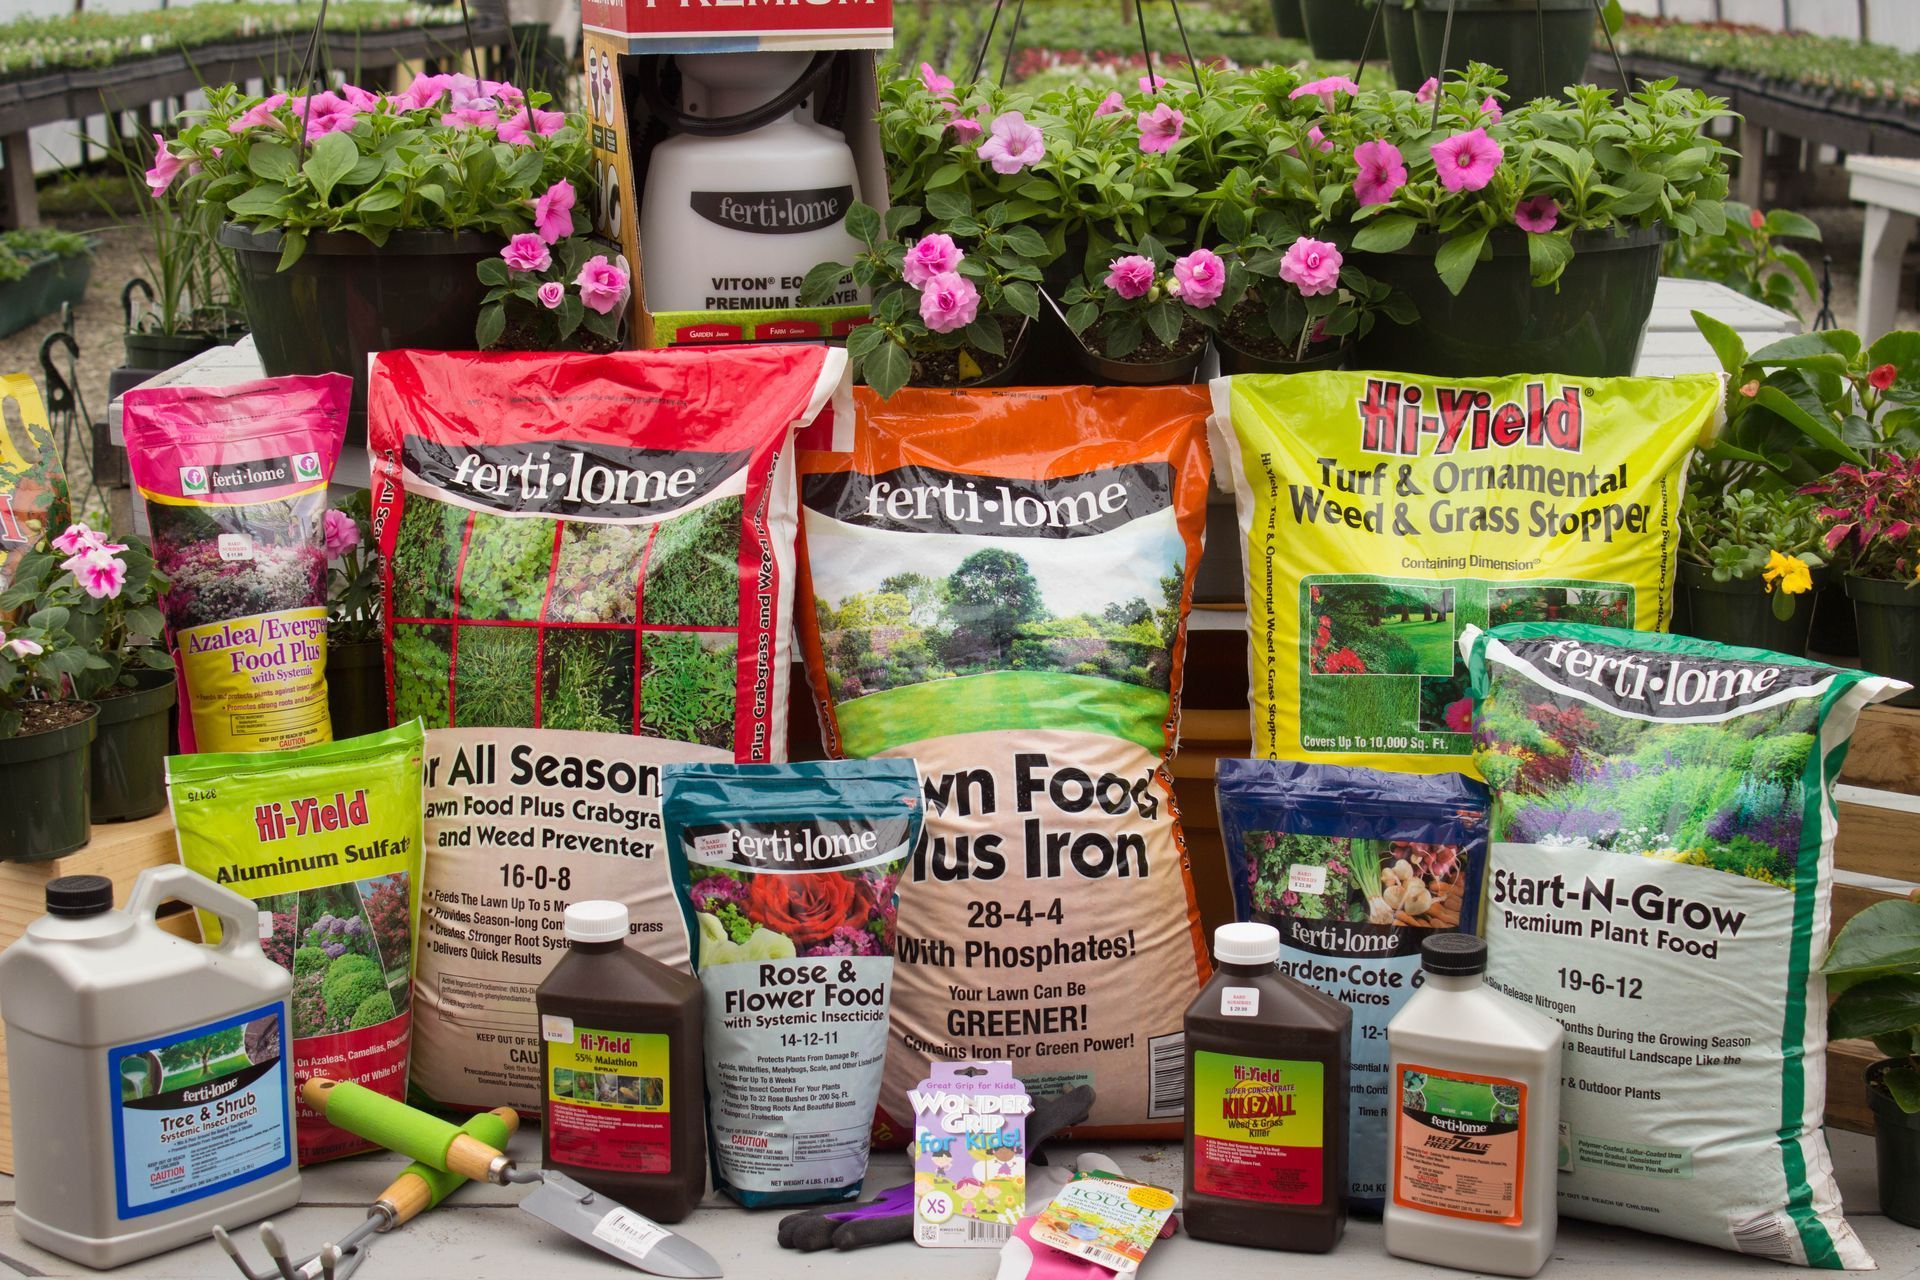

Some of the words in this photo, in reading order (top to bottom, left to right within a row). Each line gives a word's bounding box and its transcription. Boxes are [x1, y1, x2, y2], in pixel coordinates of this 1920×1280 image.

[706, 296, 789, 310] PREMIUM
[1317, 458, 1386, 494] Turf
[1396, 461, 1424, 496] &
[1433, 461, 1628, 499] Ornamental
[381, 479, 394, 505] All
[1267, 507, 1276, 531] Turf
[1289, 483, 1384, 534] Weed
[1394, 501, 1422, 537] &
[1428, 499, 1520, 534] Grass
[1528, 501, 1652, 543] Stopper
[1267, 533, 1275, 543] &
[759, 540, 772, 591] Weed
[1401, 555, 1466, 571] Containing
[1659, 530, 1670, 592] Containing
[1265, 546, 1276, 615] Ornamental
[760, 594, 770, 630] and
[1267, 617, 1275, 652] Weed
[230, 643, 286, 674] Food
[289, 639, 320, 664] Plus
[1267, 654, 1275, 667] &
[251, 671, 275, 684] with
[276, 665, 313, 682] Systemic
[754, 632, 769, 719] Crabgrass
[1267, 669, 1275, 701] Grass
[1267, 703, 1277, 747] Stopper
[279, 737, 306, 747] CAUTION
[752, 722, 764, 761] Plus
[1303, 735, 1335, 749] Covers
[1338, 735, 1352, 750] Up
[1354, 735, 1366, 748] To
[1370, 735, 1408, 750] 10,000
[1410, 736, 1429, 752] Sq.
[1433, 737, 1449, 750] Ft.
[448, 743, 495, 786] All
[1015, 752, 1160, 821] Food
[464, 796, 513, 816] Food
[521, 796, 565, 818] Plus
[438, 826, 471, 848] and
[477, 826, 535, 848] Weed
[542, 828, 655, 859] Preventer
[1024, 818, 1149, 880] Iron
[216, 852, 339, 884] Aluminum
[500, 864, 571, 891] 16-0-8
[434, 890, 460, 907] Feeds
[461, 893, 478, 907] The
[480, 896, 508, 909] Lawn
[511, 897, 526, 913] Up
[528, 899, 541, 911] To
[543, 900, 551, 912] 5
[967, 898, 1064, 929] 28-4-4
[1494, 868, 1747, 938] Start-N-Grow
[434, 907, 471, 925] Provides
[473, 910, 538, 931] Season-long
[434, 924, 466, 941] Creates
[467, 929, 512, 947] Stronger
[514, 934, 541, 948] Root
[1505, 911, 1583, 937] Premium
[1590, 920, 1649, 947] Plant
[1657, 930, 1718, 960] Food
[433, 941, 468, 958] Delivers
[470, 945, 500, 961] Quick
[501, 949, 542, 965] Results
[897, 935, 955, 968] With
[965, 930, 1136, 972] Phosphates!
[759, 964, 827, 987] Rose
[838, 960, 857, 984] &
[1558, 967, 1643, 1000] 19-6-12
[725, 988, 816, 1014] Flower
[825, 983, 884, 1007] Food
[948, 984, 983, 1002] Your
[987, 984, 1029, 1002] Lawn
[1033, 984, 1062, 1001] Can
[1067, 981, 1086, 997] Be
[1339, 989, 1390, 1006] Micros
[1503, 984, 1533, 1003] Release
[1535, 994, 1577, 1014] Nitrogen
[724, 1015, 751, 1029] with
[756, 1010, 817, 1029] Systemic
[822, 1009, 884, 1023] Insecticide
[947, 1003, 1088, 1038] GREENER!
[477, 1032, 496, 1043] KEEP
[497, 1034, 513, 1045] OUT
[515, 1036, 526, 1046] OF
[781, 1030, 838, 1047] 14-12-11
[904, 1034, 967, 1060] Contains
[971, 1044, 1002, 1059] Iron
[1006, 1043, 1030, 1058] For
[1036, 1039, 1079, 1057] Green
[1083, 1033, 1135, 1053] Power!
[1597, 1025, 1634, 1045] During
[1637, 1030, 1656, 1045] the
[1659, 1033, 1708, 1050] Growing
[1711, 1035, 1751, 1048] Season
[575, 1053, 593, 1062] 55%
[595, 1055, 638, 1068] Malathion
[757, 1054, 784, 1063] Protects
[785, 1054, 806, 1063] Plants
[807, 1053, 823, 1062] From
[825, 1052, 849, 1061] Damage
[1567, 1042, 1575, 1051] a
[1577, 1041, 1626, 1060] Beautiful
[1629, 1050, 1692, 1067] Landscape
[1695, 1054, 1720, 1066] Like
[1723, 1055, 1742, 1065] the
[926, 1082, 951, 1090] Great
[955, 1082, 974, 1091] Grip
[978, 1082, 992, 1090] for
[994, 1082, 1016, 1090] Kids!
[1225, 1087, 1246, 1095] SUPER
[1247, 1084, 1295, 1095] CONCENTRATE
[1568, 1077, 1576, 1090] &
[1579, 1079, 1622, 1097] Outdoor
[1625, 1087, 1661, 1101] Plants
[160, 1113, 194, 1132] Tree
[200, 1106, 211, 1121] &
[216, 1092, 256, 1116] Shrub
[906, 1090, 1036, 1117] WONDER
[1358, 1107, 1379, 1117] Time
[161, 1124, 201, 1143] Systemic
[203, 1117, 228, 1131] Insect
[231, 1106, 257, 1122] Drench
[941, 1112, 1006, 1134] GRIP
[731, 1135, 768, 1148] CAUTION
[919, 1132, 957, 1153] for
[150, 1166, 185, 1182] CAUTION
[1416, 1174, 1439, 1184] CAUTION
[926, 1199, 946, 1214] XS
